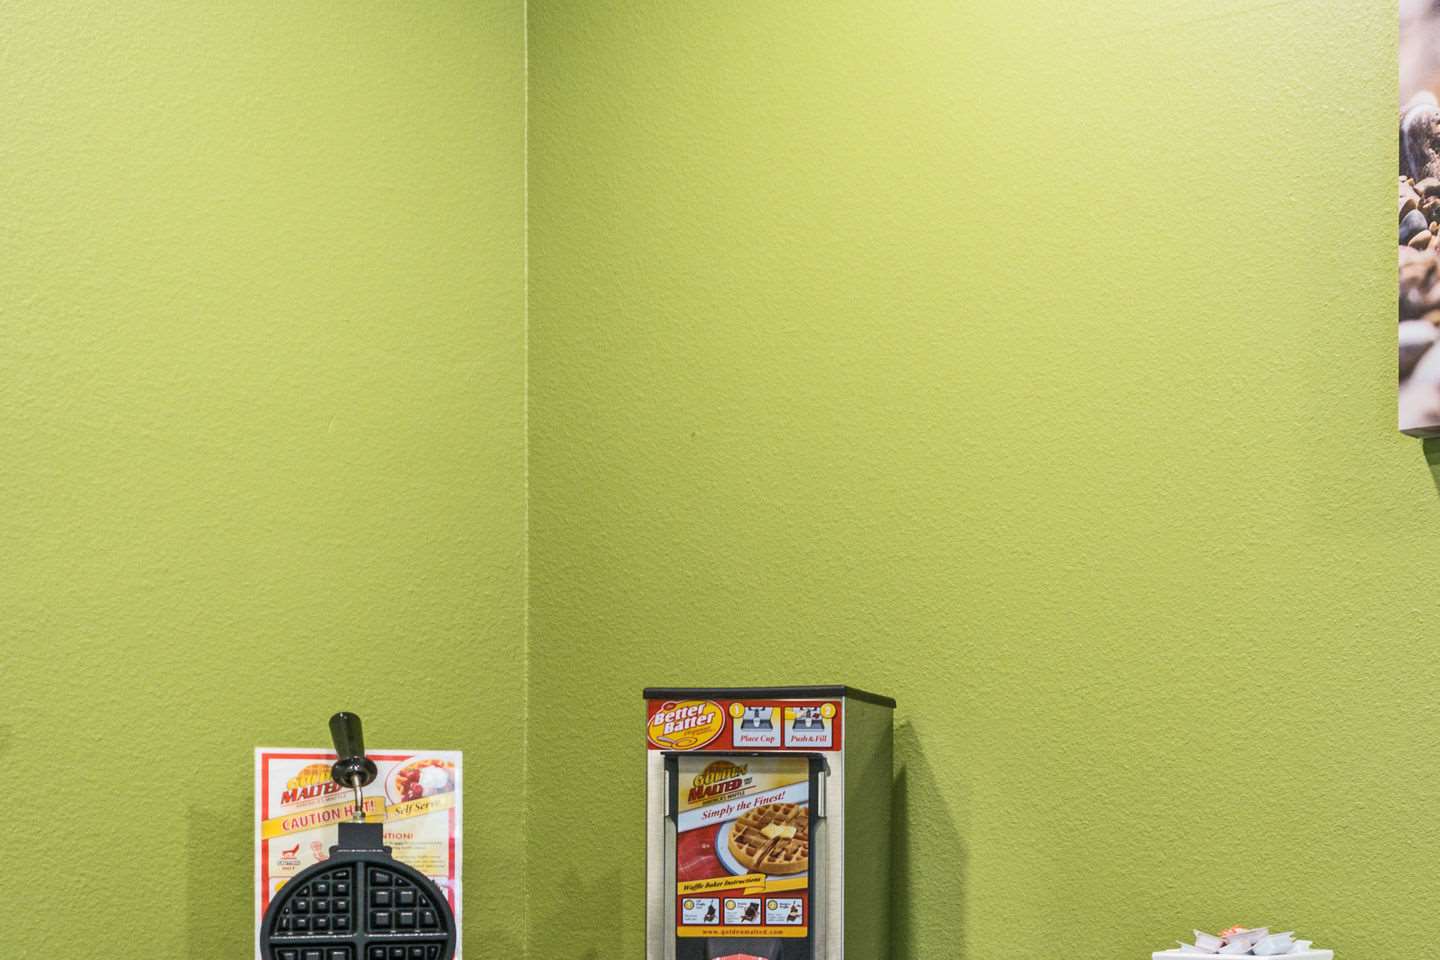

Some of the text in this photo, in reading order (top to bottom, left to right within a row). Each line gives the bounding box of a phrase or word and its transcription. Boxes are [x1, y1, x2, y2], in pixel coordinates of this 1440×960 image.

[654, 703, 706, 726] Better
[664, 712, 715, 735] Batter
[740, 735, 775, 744] Place Cup
[815, 735, 828, 743] Fill
[687, 778, 743, 802] MALTED
[282, 808, 341, 831] CAUTION
[345, 800, 376, 817] HT!
[395, 805, 412, 816] Self
[702, 804, 735, 820] Simply
[736, 800, 752, 811] the
[754, 790, 786, 807] Finest!
